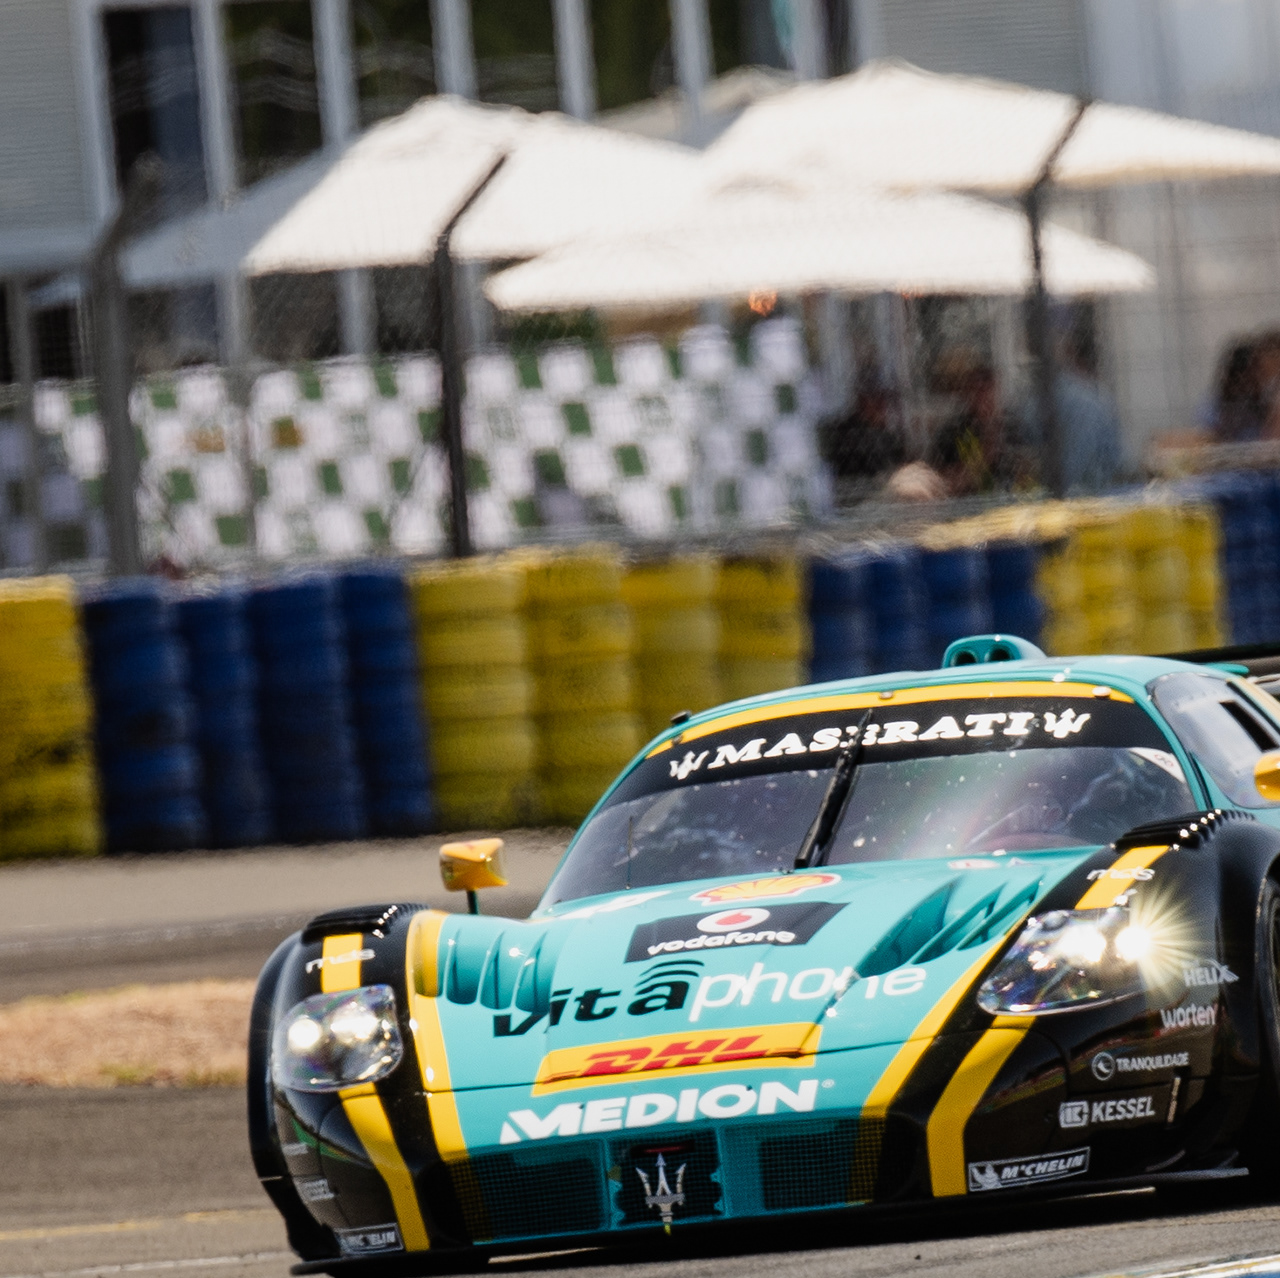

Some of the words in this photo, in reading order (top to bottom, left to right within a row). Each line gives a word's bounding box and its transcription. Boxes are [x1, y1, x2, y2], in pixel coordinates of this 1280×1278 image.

[647, 926, 796, 956] vodafone
[1160, 1002, 1216, 1029] worten
[582, 1035, 768, 1077] DHL
[1116, 1052, 1189, 1073] TRANQUILIDADE
[500, 1079, 819, 1145] MEDION
[1091, 1096, 1155, 1123] KESSEL
